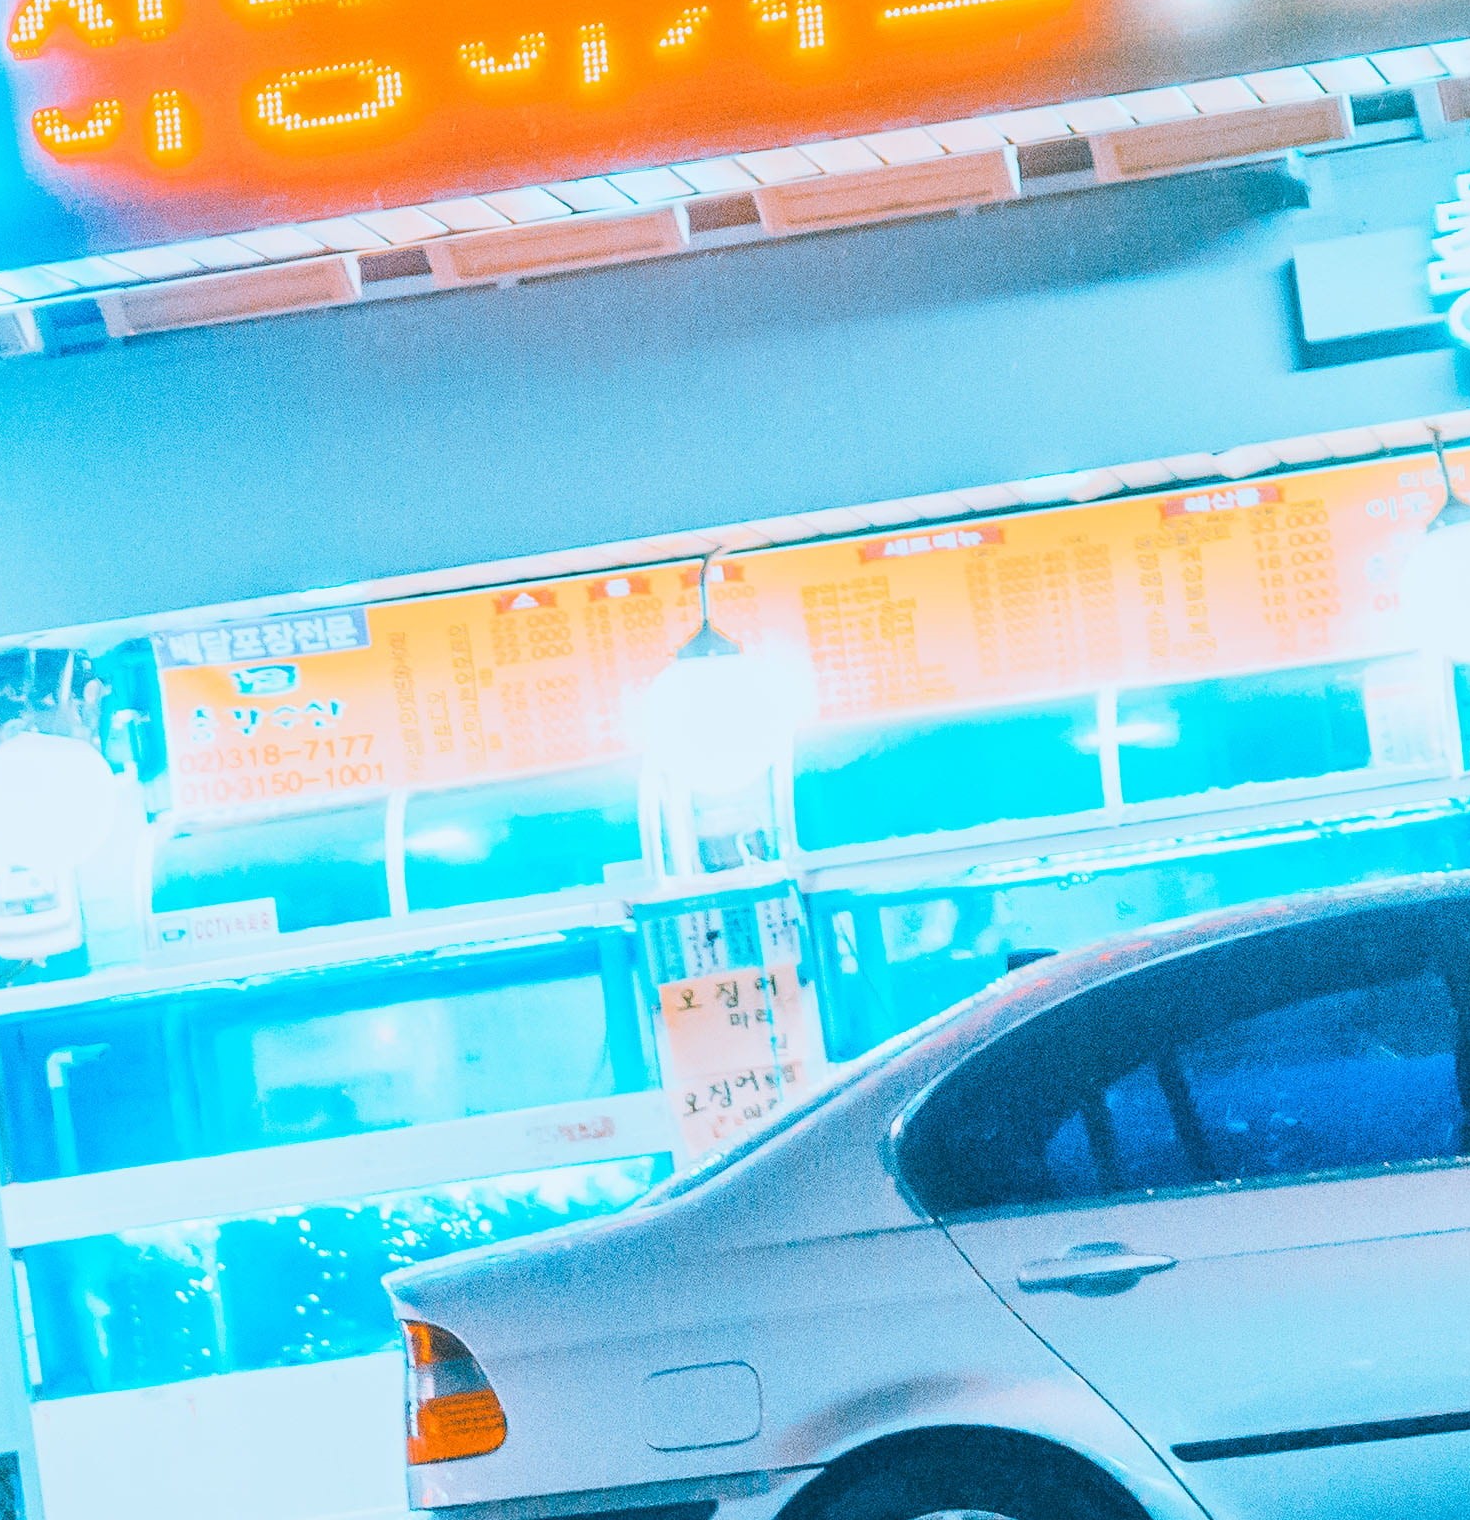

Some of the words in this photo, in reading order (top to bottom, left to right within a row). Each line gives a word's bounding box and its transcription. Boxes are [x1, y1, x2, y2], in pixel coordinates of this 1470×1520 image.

[168, 614, 357, 663] 배달포장전문
[179, 734, 374, 774] 02)318-7177
[678, 974, 778, 1011] 오징어
